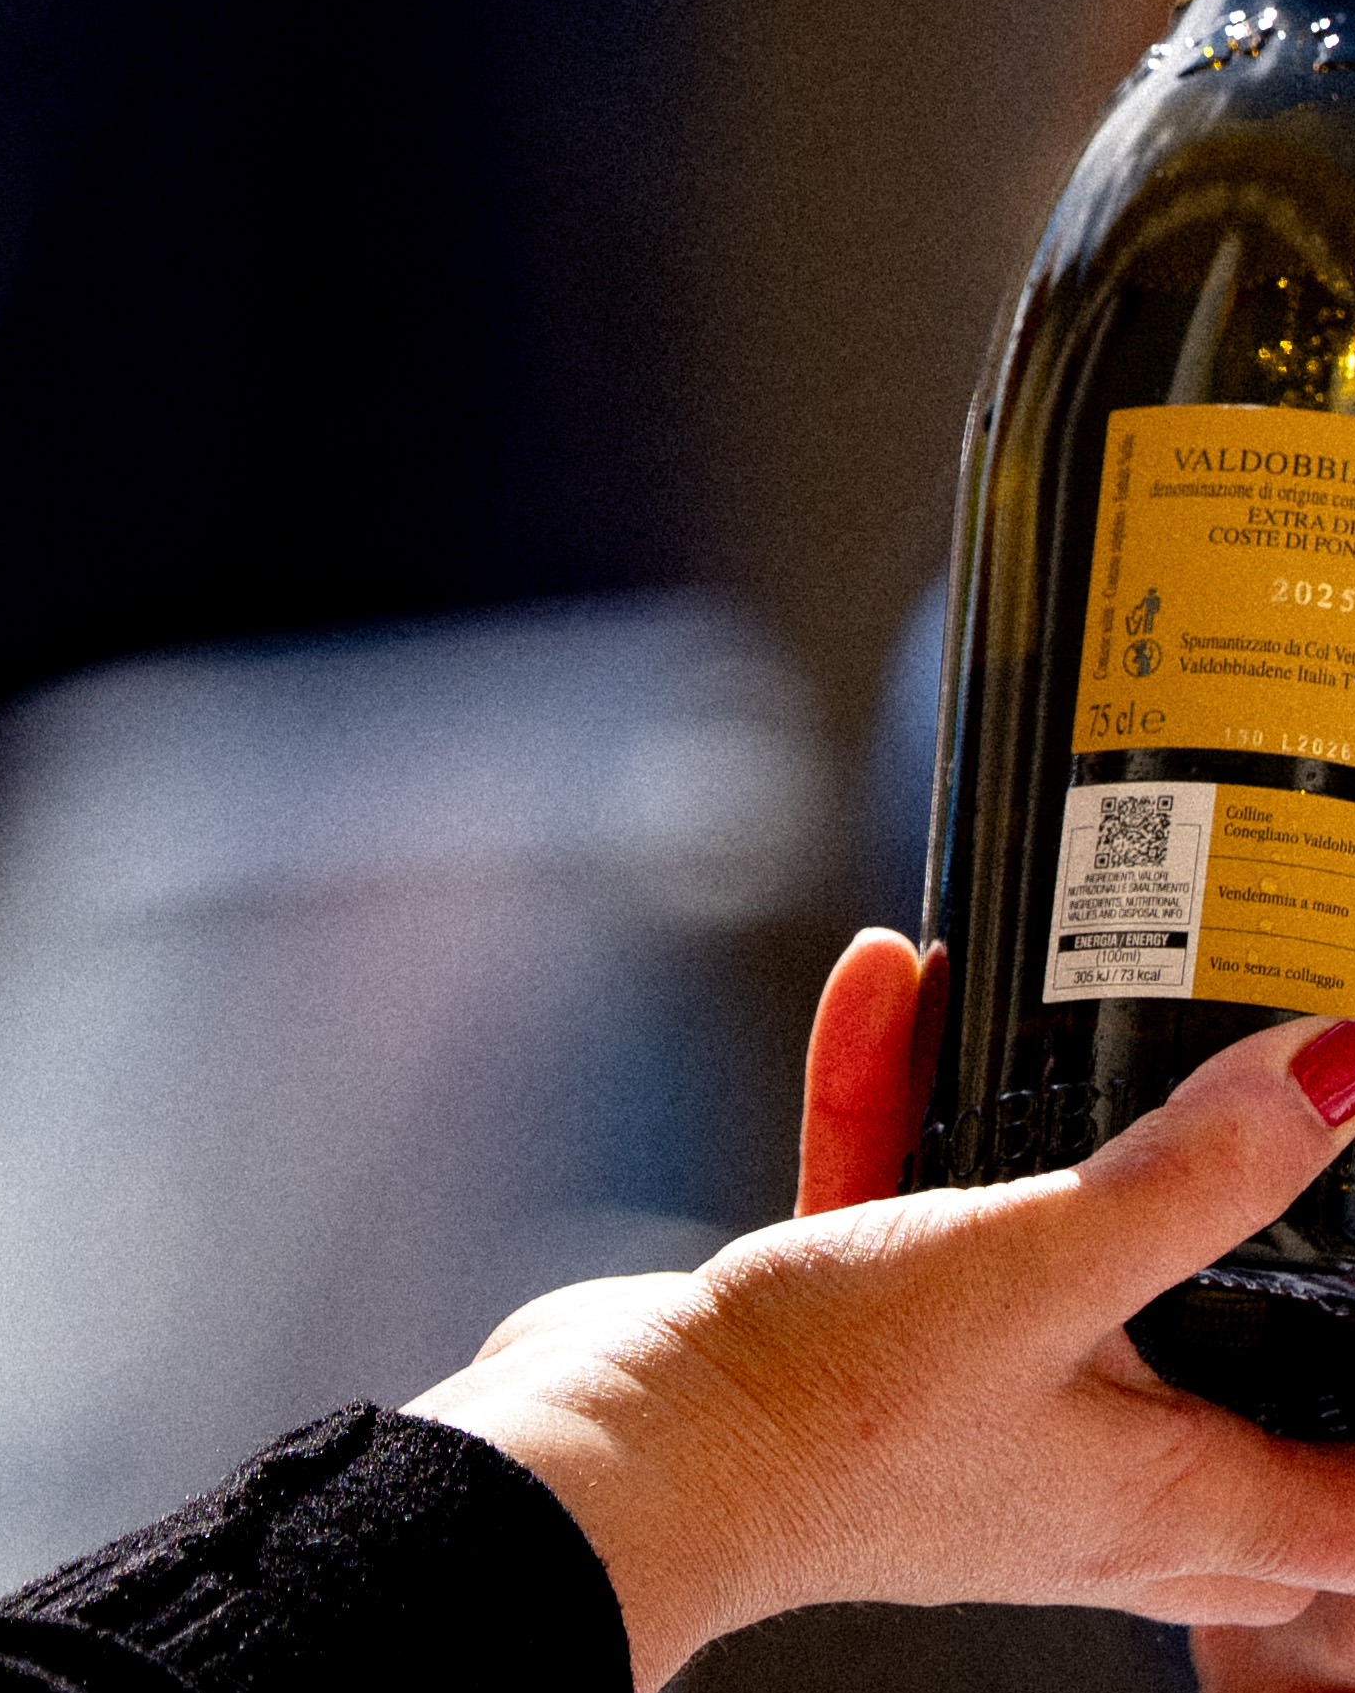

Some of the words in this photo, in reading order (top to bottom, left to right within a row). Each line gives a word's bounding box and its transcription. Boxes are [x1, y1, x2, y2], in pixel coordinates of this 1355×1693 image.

[1149, 480, 1254, 501] denominazione
[1259, 483, 1272, 501] di
[1277, 487, 1329, 508] origine
[1248, 507, 1324, 533] EXTRA
[1208, 526, 1279, 549] COSTE
[1286, 531, 1308, 551] DI
[1272, 577, 1355, 613] 2025
[1180, 632, 1281, 657] Spumantizzato
[1284, 638, 1302, 657] da
[1304, 640, 1330, 660] Col
[1180, 657, 1293, 681] Valdobbiadene
[1297, 664, 1337, 687] Italia
[1089, 703, 1112, 738] 75
[1115, 700, 1136, 736] cl
[1281, 733, 1352, 761] L2026
[1225, 805, 1273, 823] Colline
[1223, 823, 1299, 844] Conegliano
[1128, 882, 1190, 894] SMALTIMENTO
[1138, 870, 1169, 881] VALORI
[1125, 896, 1181, 908] NUTRITIONAL
[1218, 885, 1296, 909] Vendemmia
[1300, 899, 1308, 910] a
[1312, 901, 1350, 917] mano
[1067, 910, 1099, 922] VALUES
[1099, 908, 1116, 919] AND
[1118, 908, 1160, 919] DISPOSAL
[1162, 908, 1183, 919] INFO
[1074, 934, 1118, 950] ENERGIA
[1125, 932, 1170, 948] ENERGY
[1095, 949, 1142, 966] (100ml)
[1096, 969, 1110, 982] kJ
[1120, 969, 1134, 982] 73
[1136, 968, 1162, 982] kcal
[1209, 956, 1240, 973] Vino
[1243, 962, 1281, 978] senza
[1284, 967, 1345, 990] collaggio
